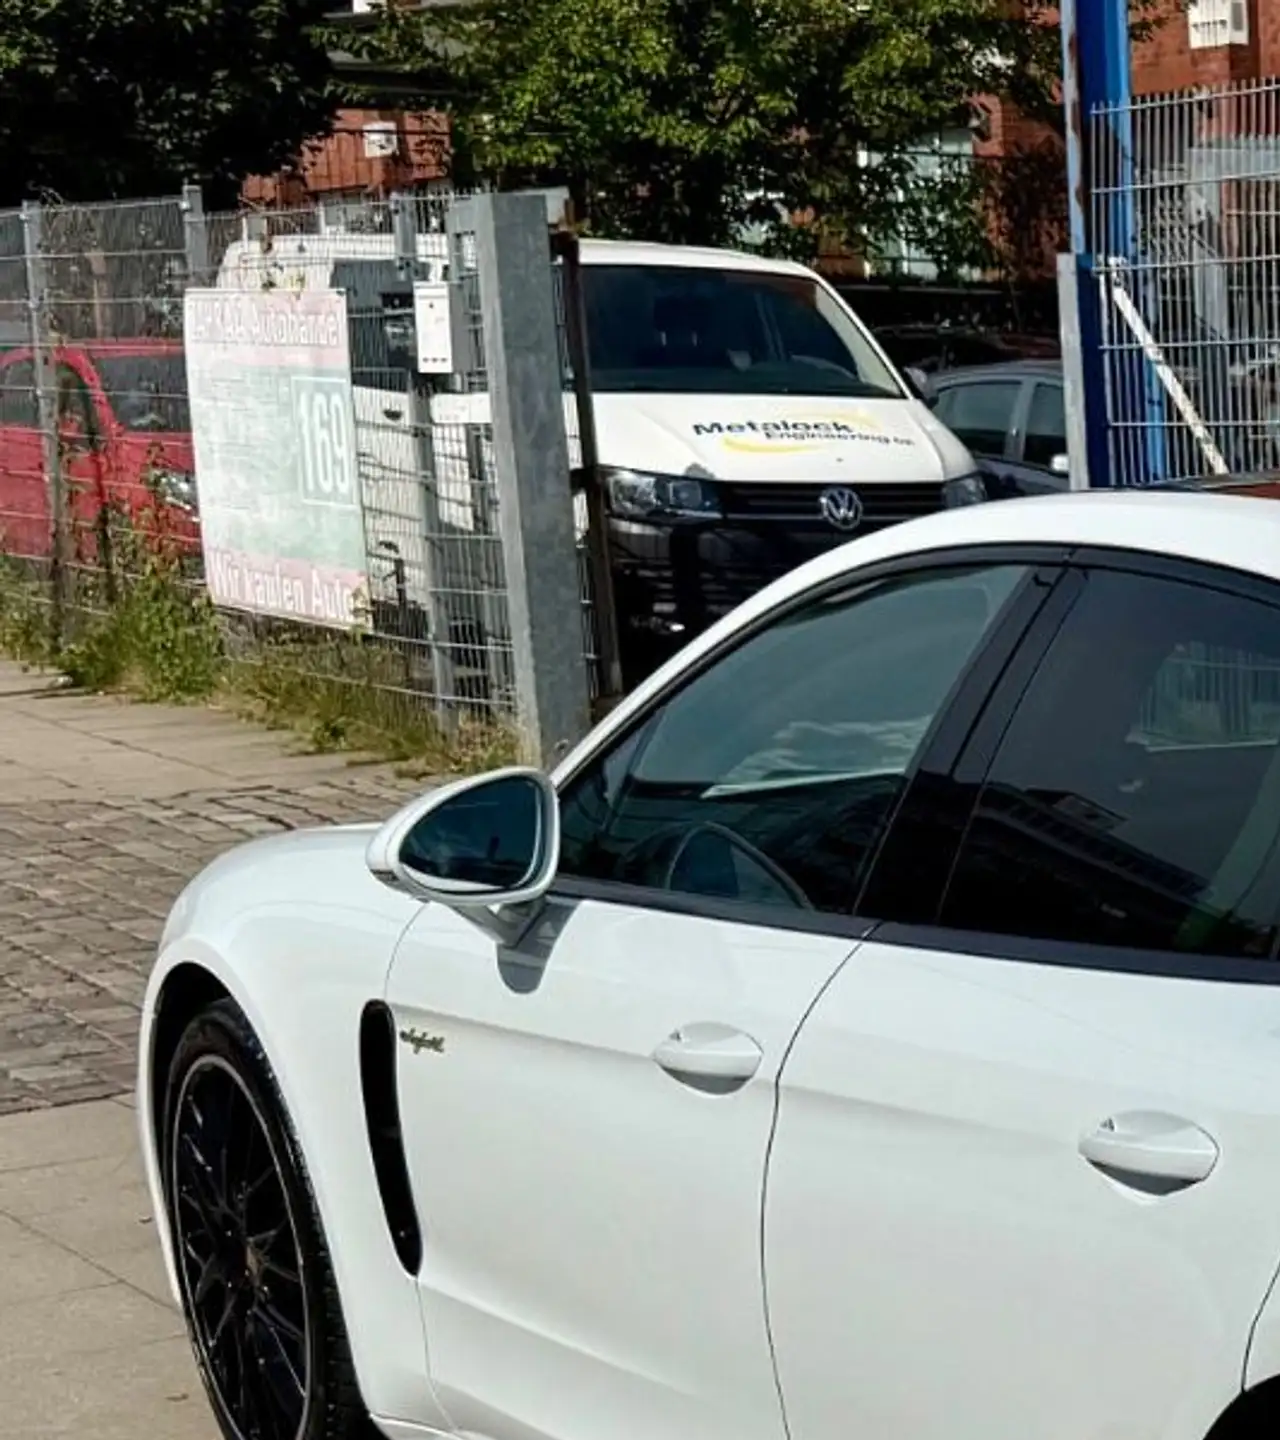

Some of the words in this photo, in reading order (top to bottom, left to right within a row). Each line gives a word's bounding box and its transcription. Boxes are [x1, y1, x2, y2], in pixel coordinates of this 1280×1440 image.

[299, 391, 350, 494] 169
[692, 420, 854, 436] Metalock
[242, 558, 306, 615] kaufen
